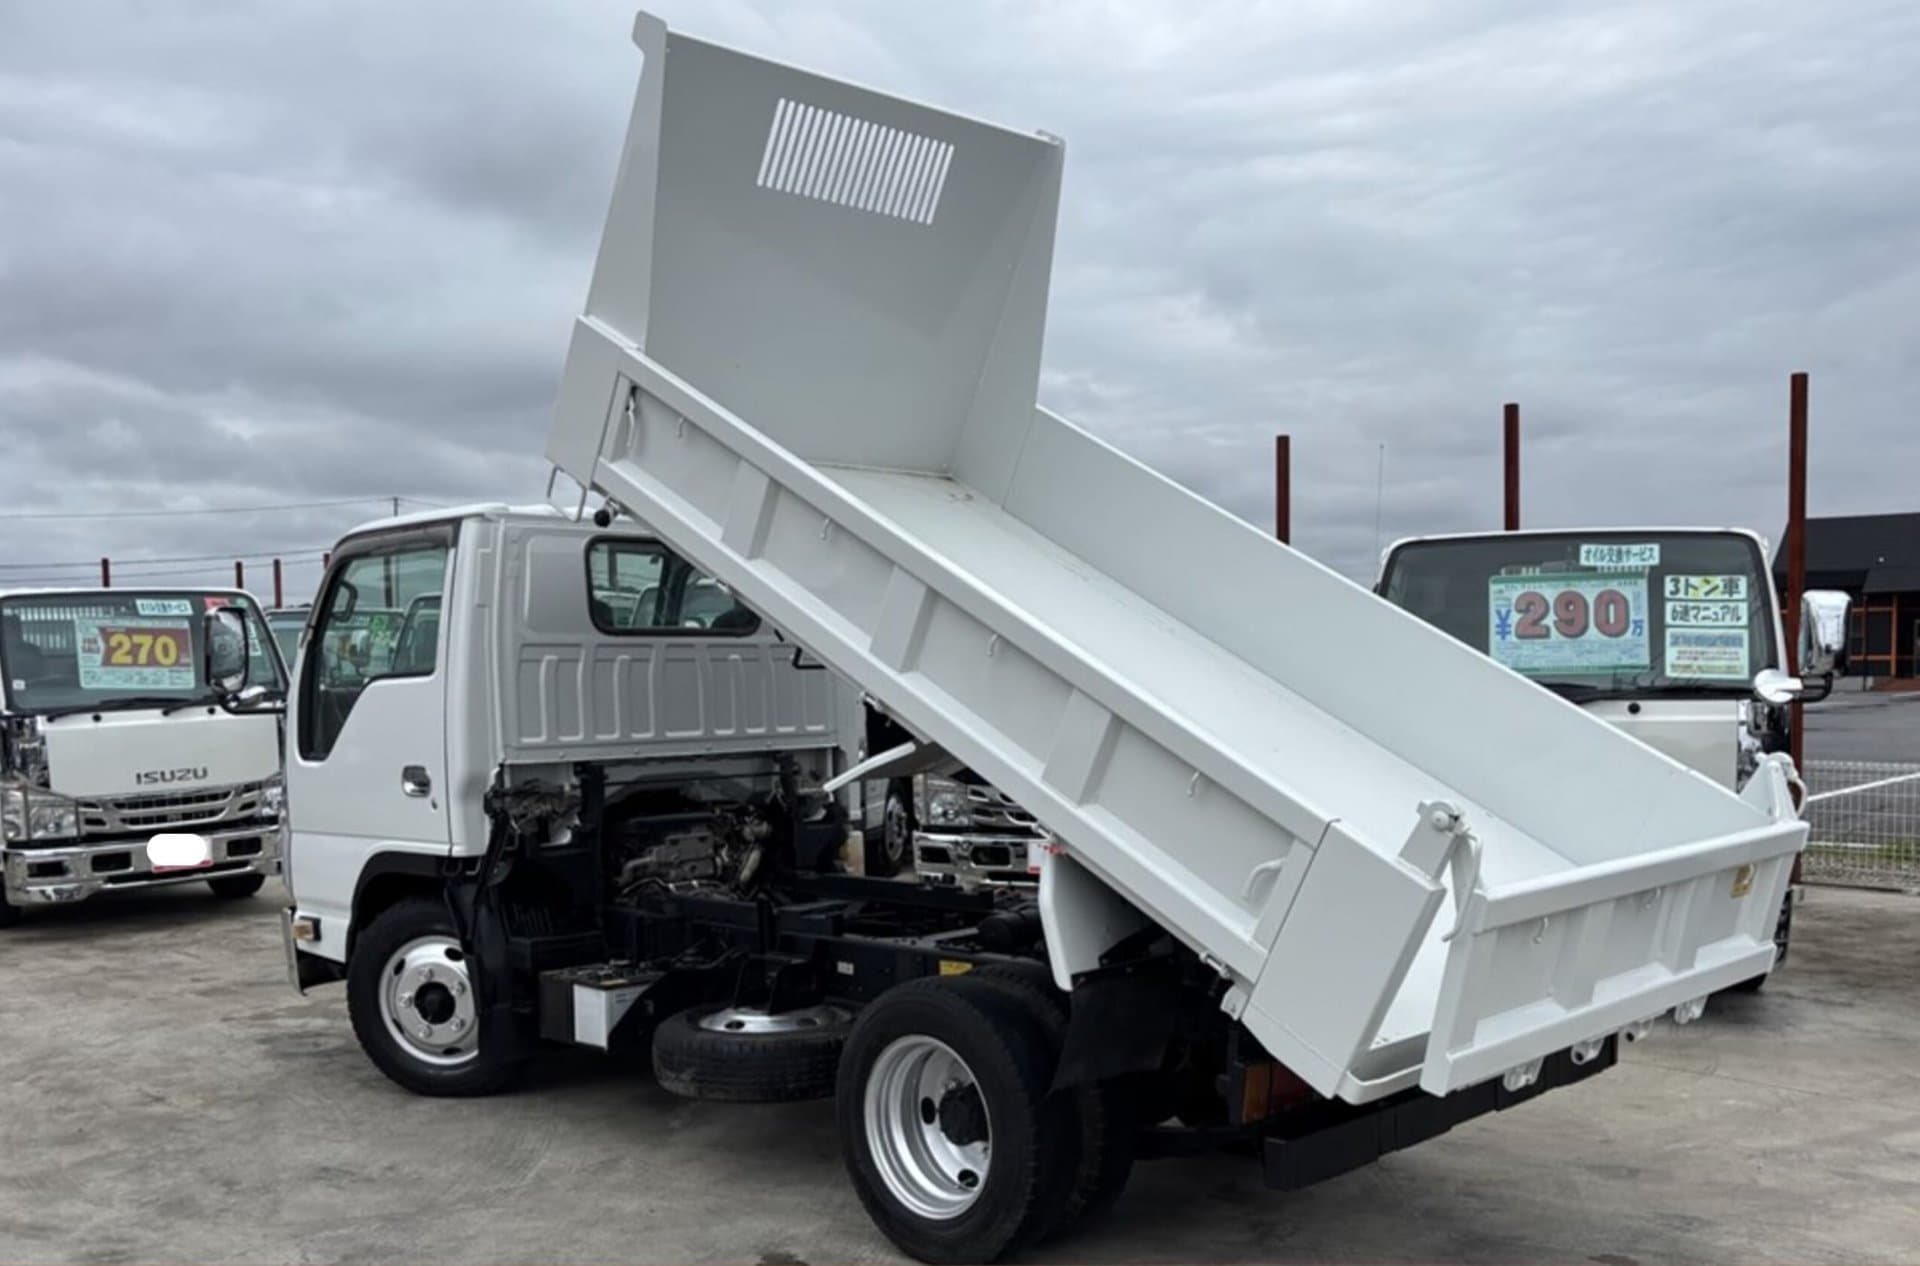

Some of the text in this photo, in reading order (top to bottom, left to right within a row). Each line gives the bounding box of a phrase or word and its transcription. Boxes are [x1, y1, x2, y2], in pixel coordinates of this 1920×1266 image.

[1669, 577, 1741, 597] 3トン車
[1514, 589, 1630, 640] 290
[109, 633, 178, 666] 270
[136, 766, 208, 785] ISUZU
